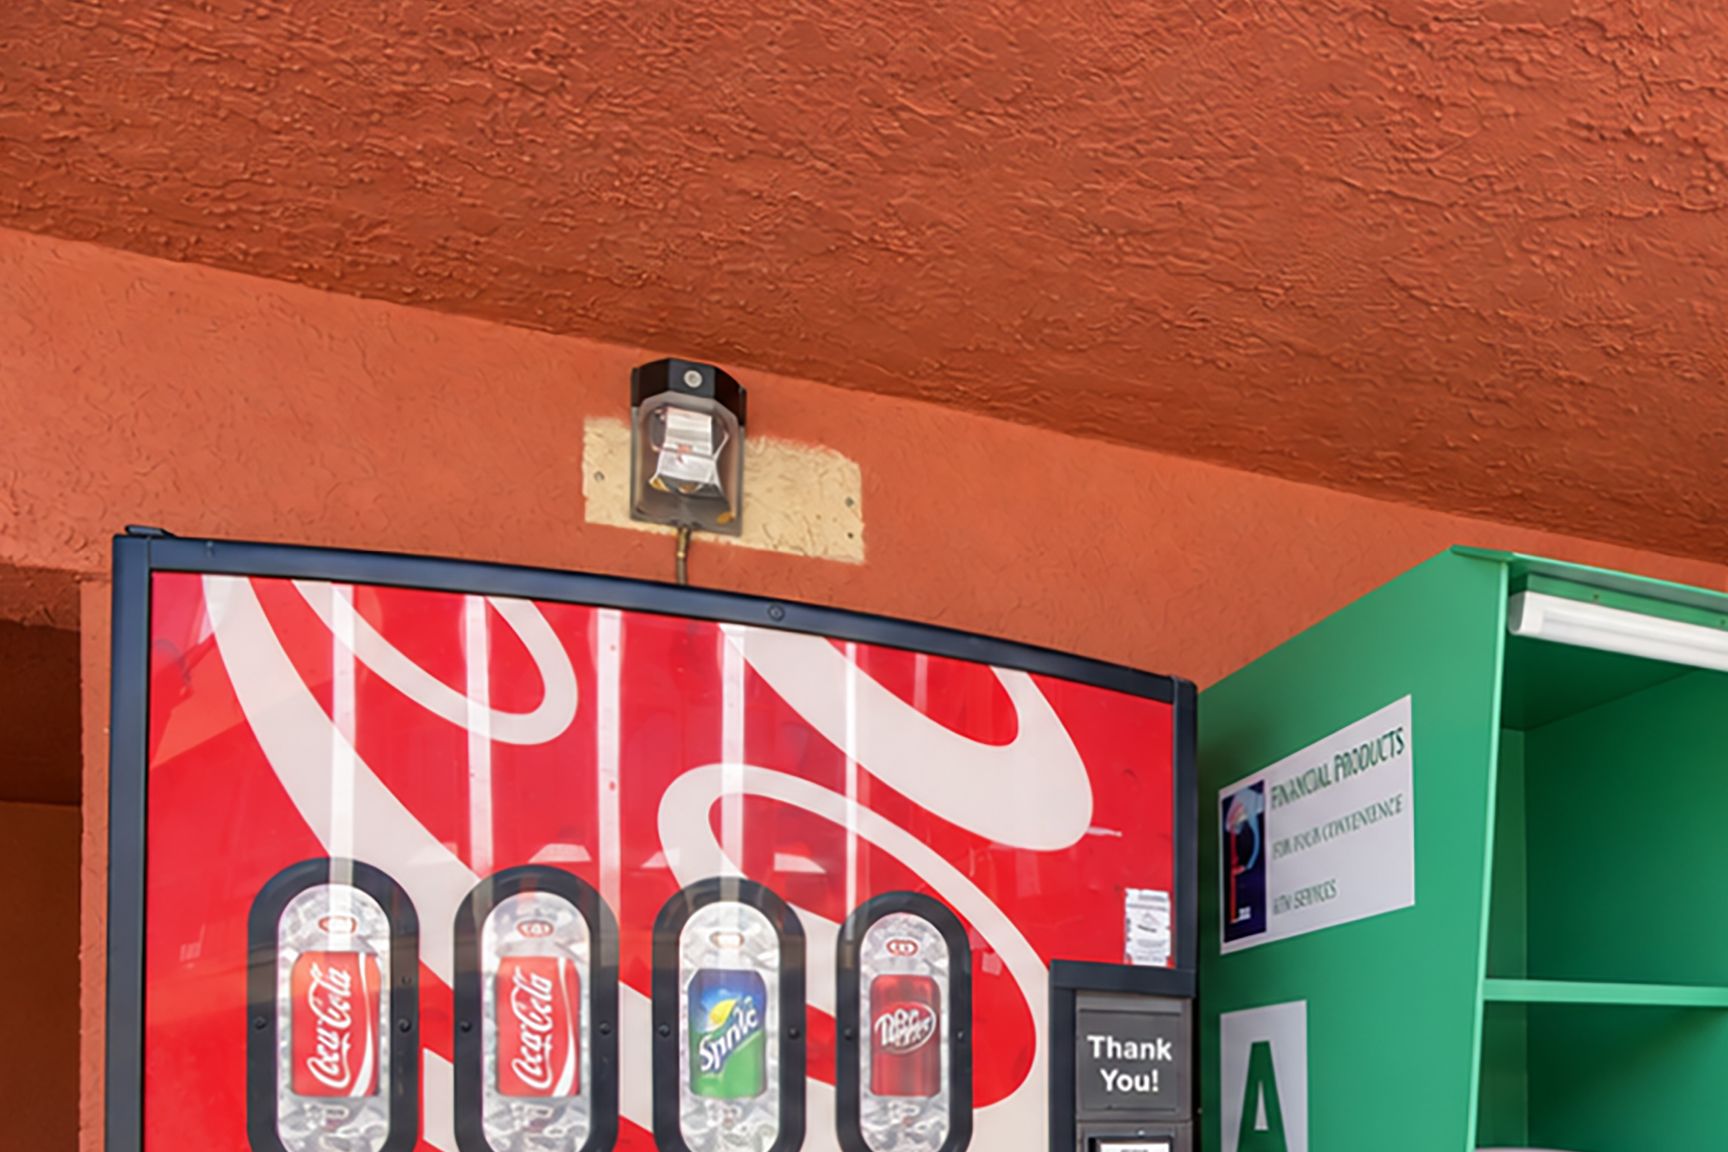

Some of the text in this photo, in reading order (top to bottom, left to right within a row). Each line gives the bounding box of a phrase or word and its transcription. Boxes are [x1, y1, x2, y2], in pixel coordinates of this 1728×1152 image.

[1270, 727, 1405, 809] FINANCIAL PRODUCTS
[1321, 794, 1403, 842] CONVENIENCE
[1293, 878, 1338, 910] SERVICES
[699, 995, 758, 1072] Sprite
[1087, 1034, 1172, 1061] Thank
[1100, 1068, 1159, 1092] You!
